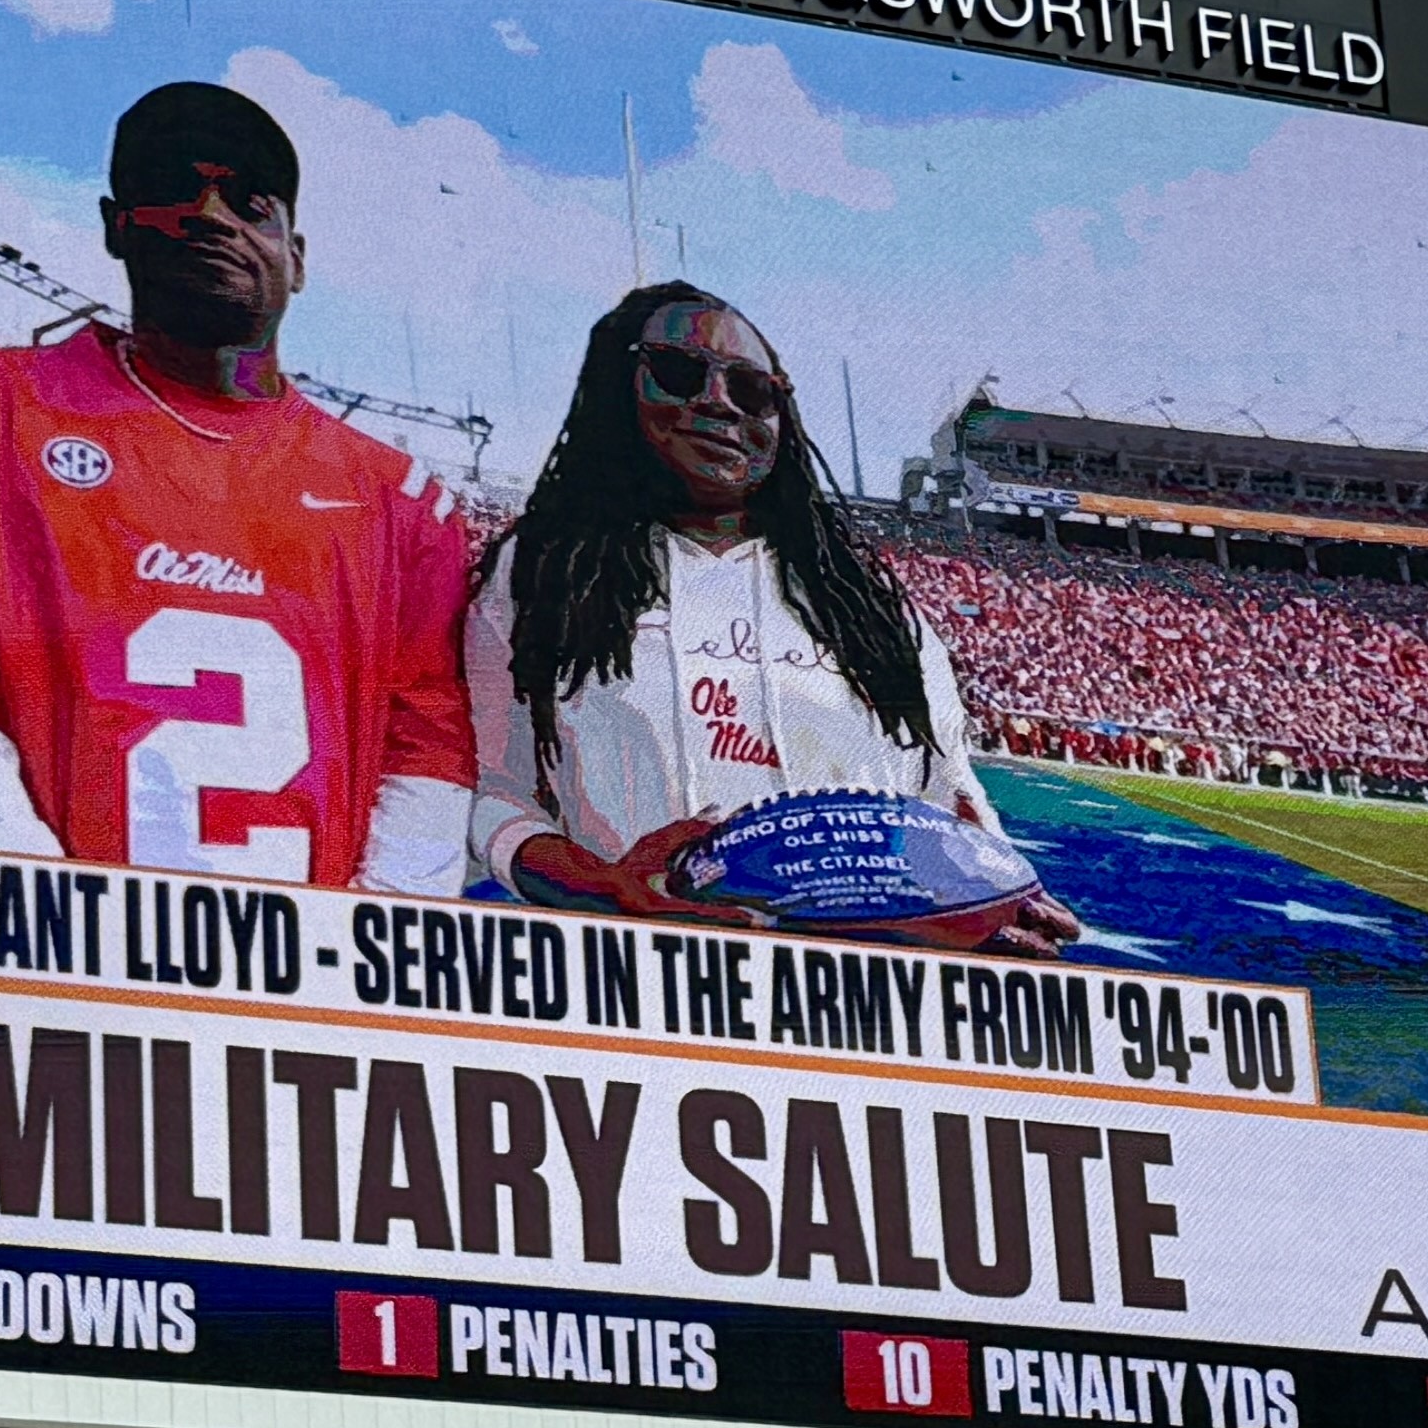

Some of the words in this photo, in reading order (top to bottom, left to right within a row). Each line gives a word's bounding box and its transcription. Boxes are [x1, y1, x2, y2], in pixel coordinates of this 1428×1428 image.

[1197, 8, 1385, 86] FIELD
[691, 676, 738, 718] Ole
[125, 607, 311, 885] 2
[706, 720, 782, 769] Miss
[780, 812, 816, 831] OF
[821, 810, 878, 826] THE
[783, 830, 826, 848] OLE
[832, 829, 885, 844] MISS
[772, 857, 815, 877] THE
[820, 853, 913, 871] CITADEL
[124, 875, 301, 996] LLOYD
[316, 945, 338, 969] -
[352, 902, 569, 1022] SERVED
[583, 921, 638, 1030] IN
[652, 932, 757, 1042] THE
[771, 944, 927, 1060] ARMY
[940, 961, 1094, 1075] FROM
[1103, 978, 1297, 1096] '94-'00
[677, 1086, 1188, 1313] SALUTE
[373, 1299, 396, 1367] 1
[451, 1304, 719, 1392] PENALTIES
[878, 1340, 932, 1407] 10
[983, 1344, 1187, 1428] PENALTY
